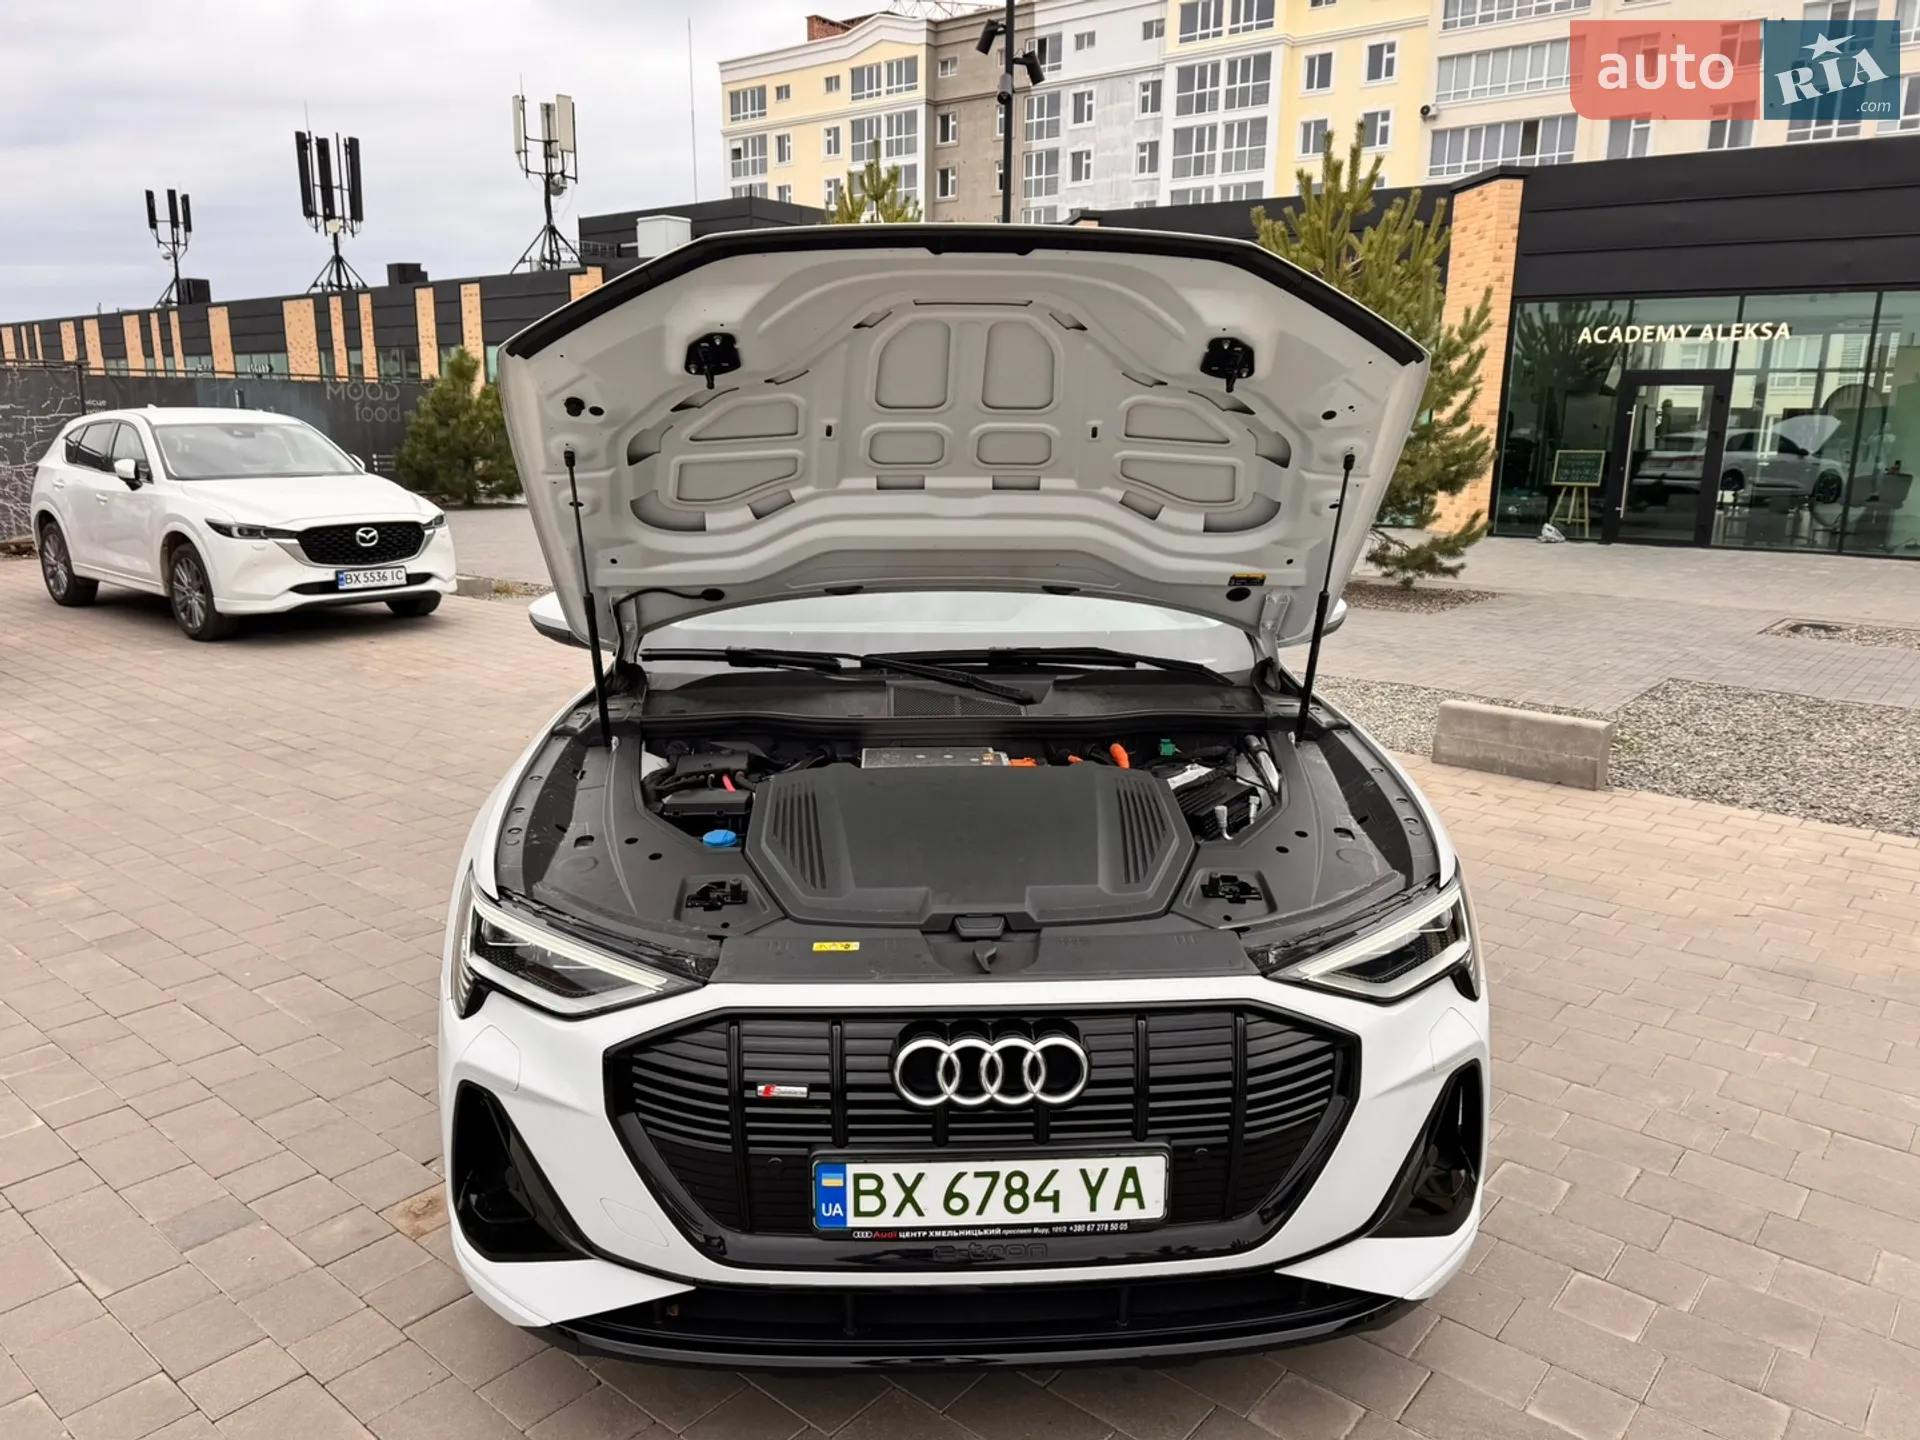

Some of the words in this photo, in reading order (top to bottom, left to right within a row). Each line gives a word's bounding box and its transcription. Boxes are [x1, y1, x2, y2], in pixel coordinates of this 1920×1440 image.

[1578, 324, 1692, 344] ACADEMY
[1699, 322, 1791, 341] ALEKSA
[355, 402, 401, 422] food
[345, 573, 361, 584] BX
[363, 571, 388, 583] 5536
[391, 570, 403, 581] IC
[853, 1173, 926, 1218] BX
[943, 1169, 1060, 1216] 6784
[1079, 1166, 1146, 1213] YA
[822, 1203, 844, 1217] UA
[873, 1231, 897, 1239] Audi
[899, 1231, 928, 1239] ЦЕНТР
[928, 1229, 1001, 1238] ХМЕЛЬНИЦЬКИЙ
[1069, 1223, 1085, 1232] +380
[1087, 1223, 1095, 1231] 67
[1097, 1223, 1108, 1231] 278
[933, 1242, 1048, 1260] e-tron
